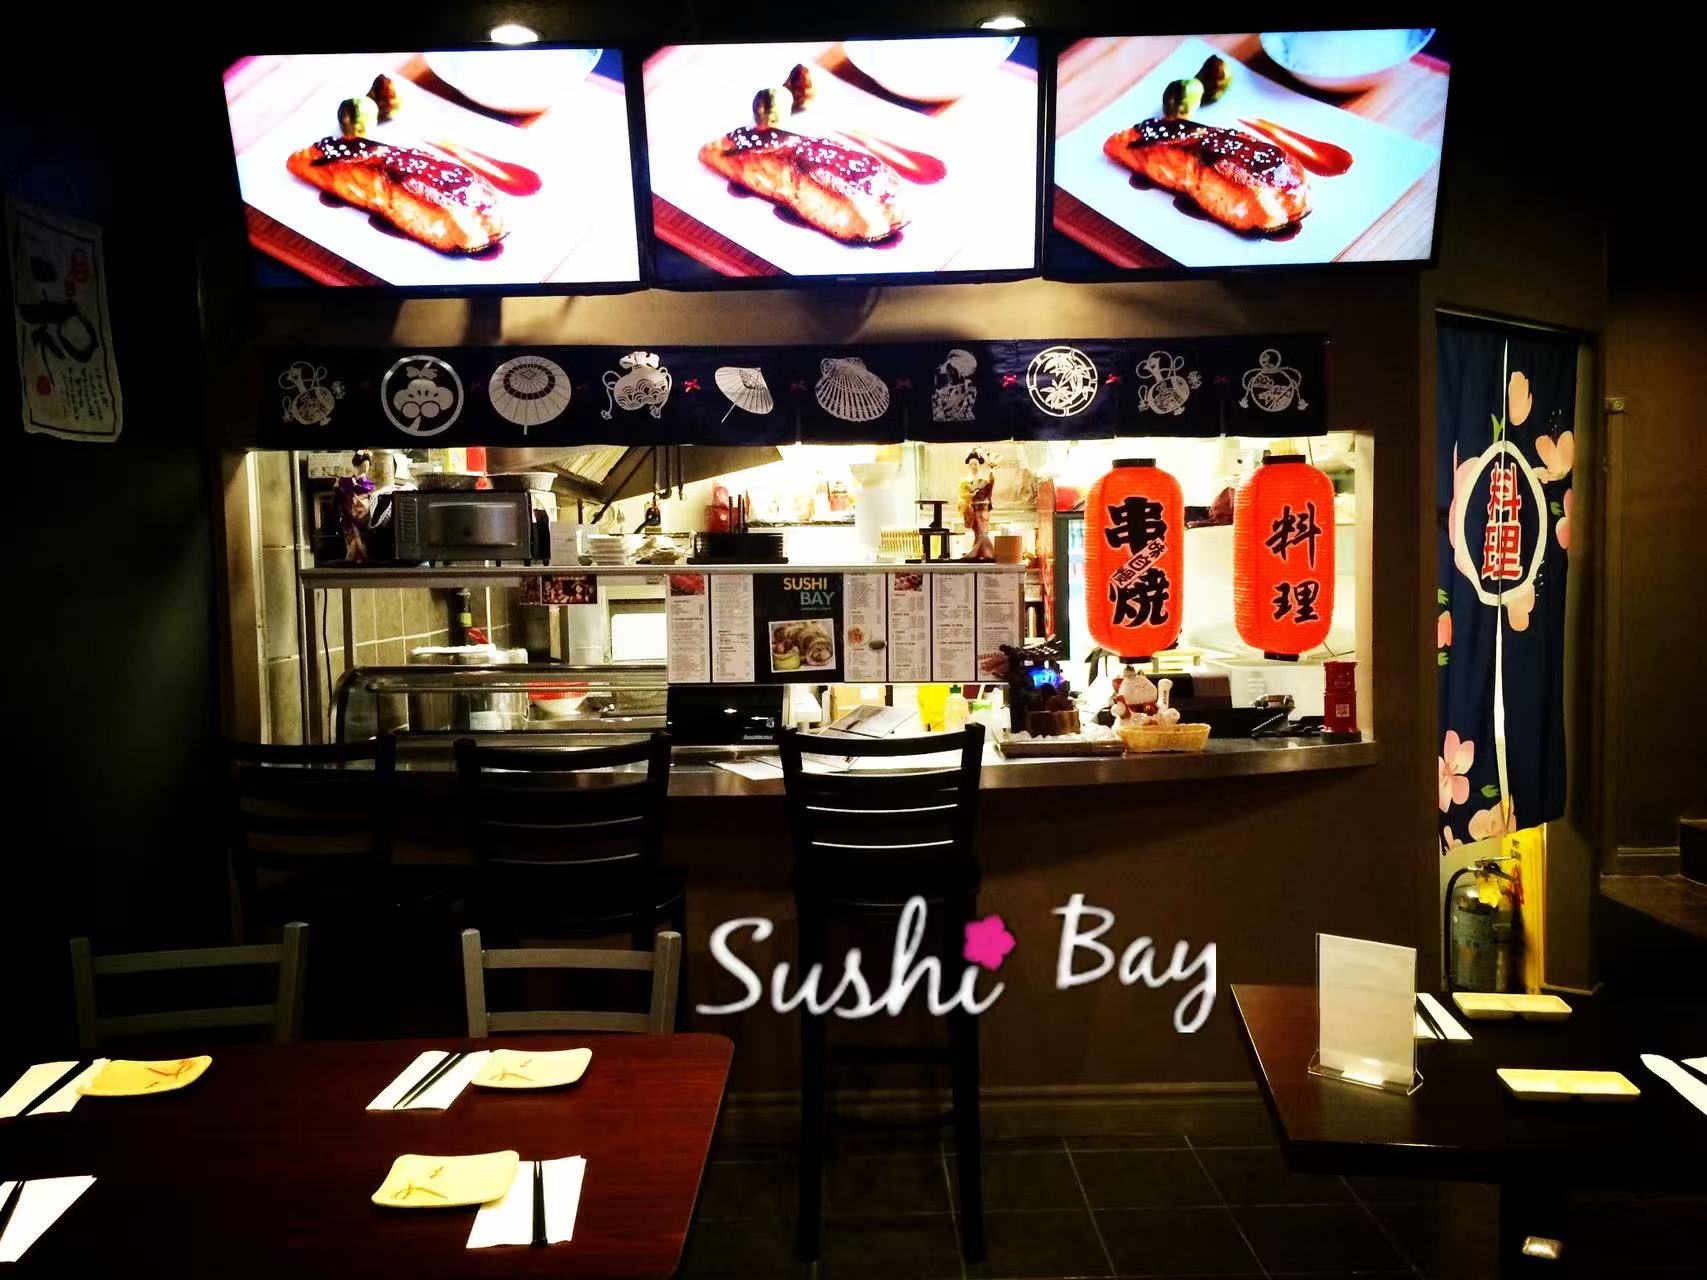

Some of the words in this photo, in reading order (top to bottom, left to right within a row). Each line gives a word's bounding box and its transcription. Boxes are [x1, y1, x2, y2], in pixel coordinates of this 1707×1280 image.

[1482, 462, 1523, 580] 料理
[783, 577, 828, 590] SUSHI
[1265, 501, 1322, 624] 料理
[800, 591, 836, 605] BAY
